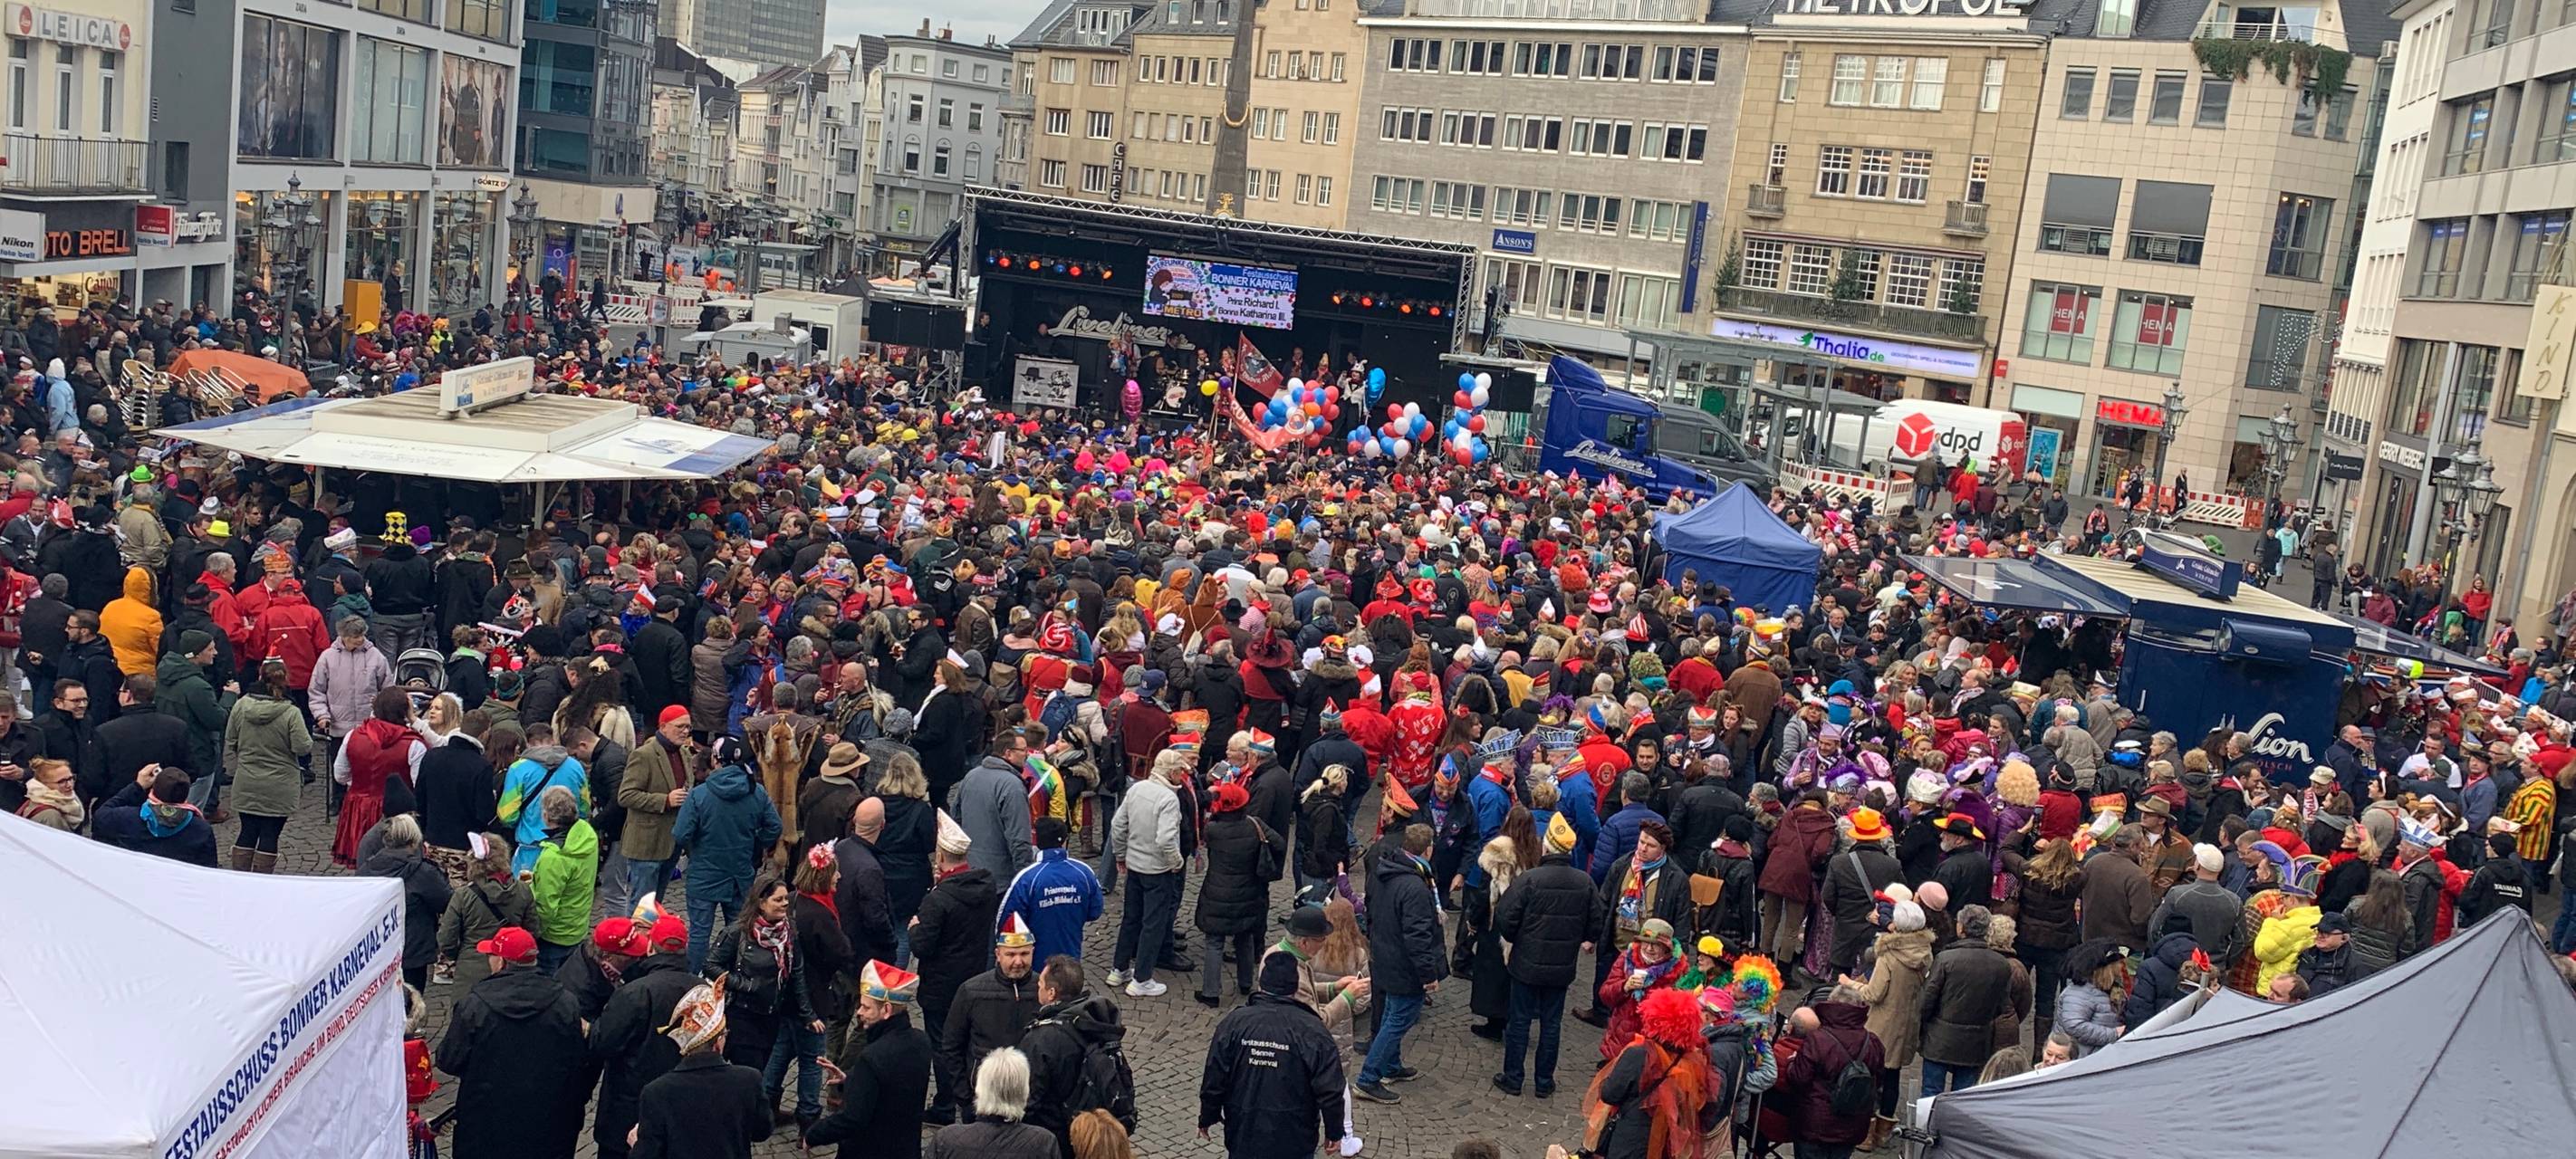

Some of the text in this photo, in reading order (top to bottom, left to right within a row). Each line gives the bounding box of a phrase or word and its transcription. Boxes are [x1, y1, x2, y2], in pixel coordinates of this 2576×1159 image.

[43, 13, 112, 44] LEICA
[1, 236, 34, 248] Nikon
[80, 229, 130, 255] BRELL
[1495, 233, 1533, 249] ANSON'S
[1211, 273, 1249, 286] BONNER
[1249, 278, 1295, 291] KARNEVAL
[1243, 269, 1293, 282] Festausschuss
[1164, 306, 1203, 317] METRO
[1227, 297, 1243, 306] Prinz
[1244, 297, 1274, 310] Richard
[1239, 309, 1277, 321] Katharina
[2536, 292, 2572, 392] KIND
[2099, 399, 2164, 427] HEMA
[1940, 426, 1983, 453] dpd
[2014, 436, 2025, 449] dpd
[280, 979, 327, 1050] BONNER
[330, 925, 380, 999] KARNEVAL
[284, 1042, 315, 1089] BRÄUCHE
[316, 1033, 325, 1054] IM
[326, 1015, 346, 1042] BUND
[345, 978, 380, 1024] DEUTSCHER
[1241, 1039, 1290, 1050] Festausschuss
[1249, 1058, 1278, 1068] Karneval
